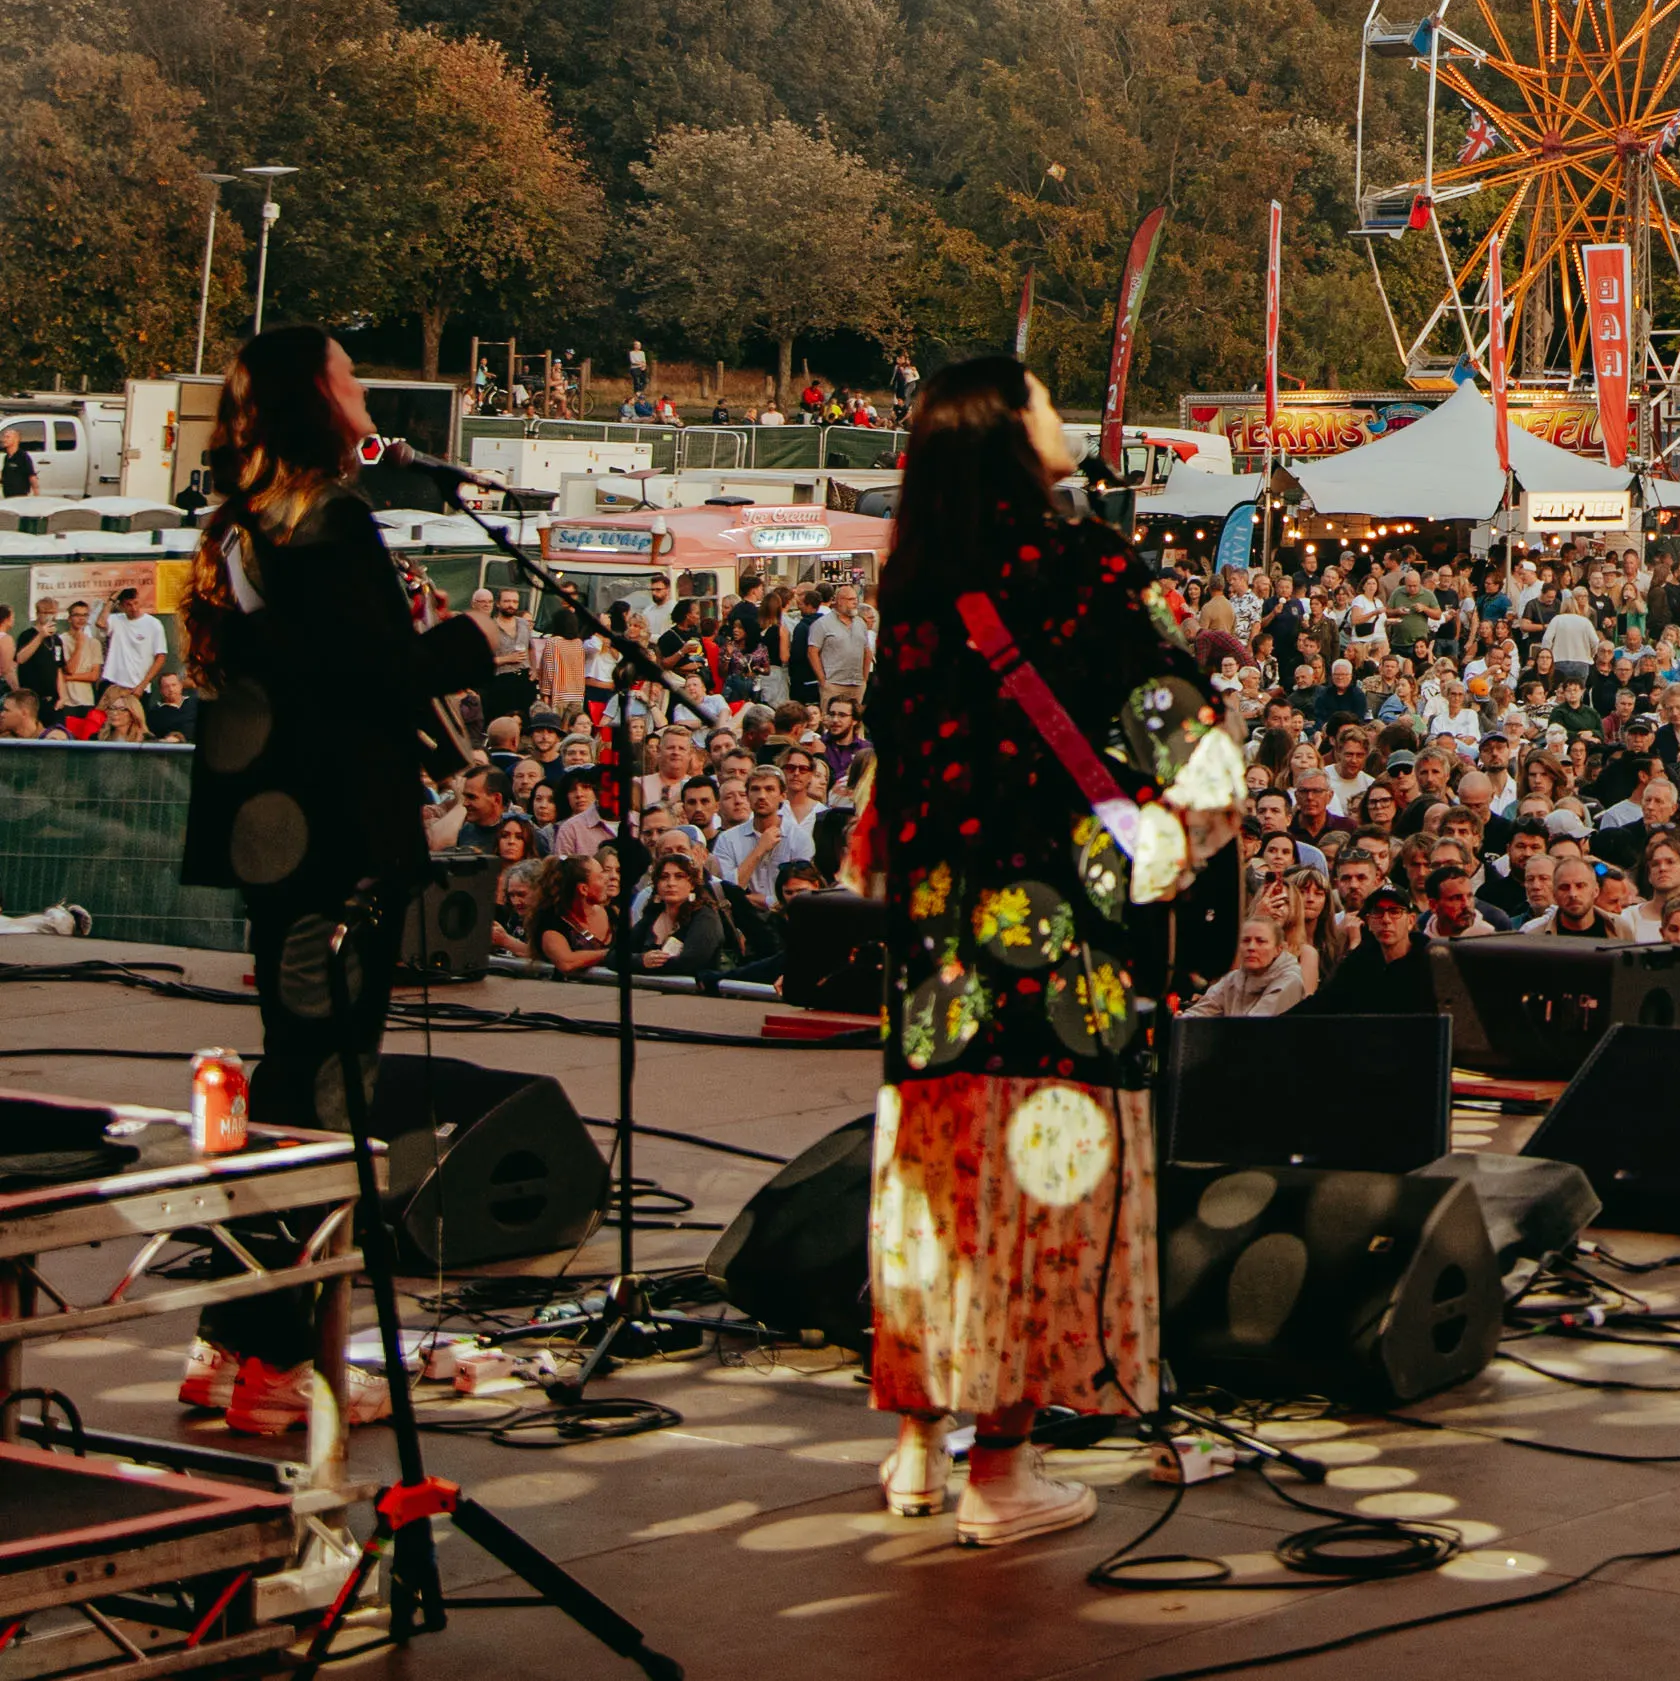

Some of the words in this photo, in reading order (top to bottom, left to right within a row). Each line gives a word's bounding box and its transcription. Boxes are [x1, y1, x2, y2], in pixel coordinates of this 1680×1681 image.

[1223, 409, 1366, 451] FERRIS
[742, 510, 768, 524] Ice
[771, 507, 821, 523] Cream
[558, 530, 594, 547] Soft
[598, 532, 652, 550] Whip
[758, 531, 785, 545] Soft
[789, 530, 824, 543] Whip
